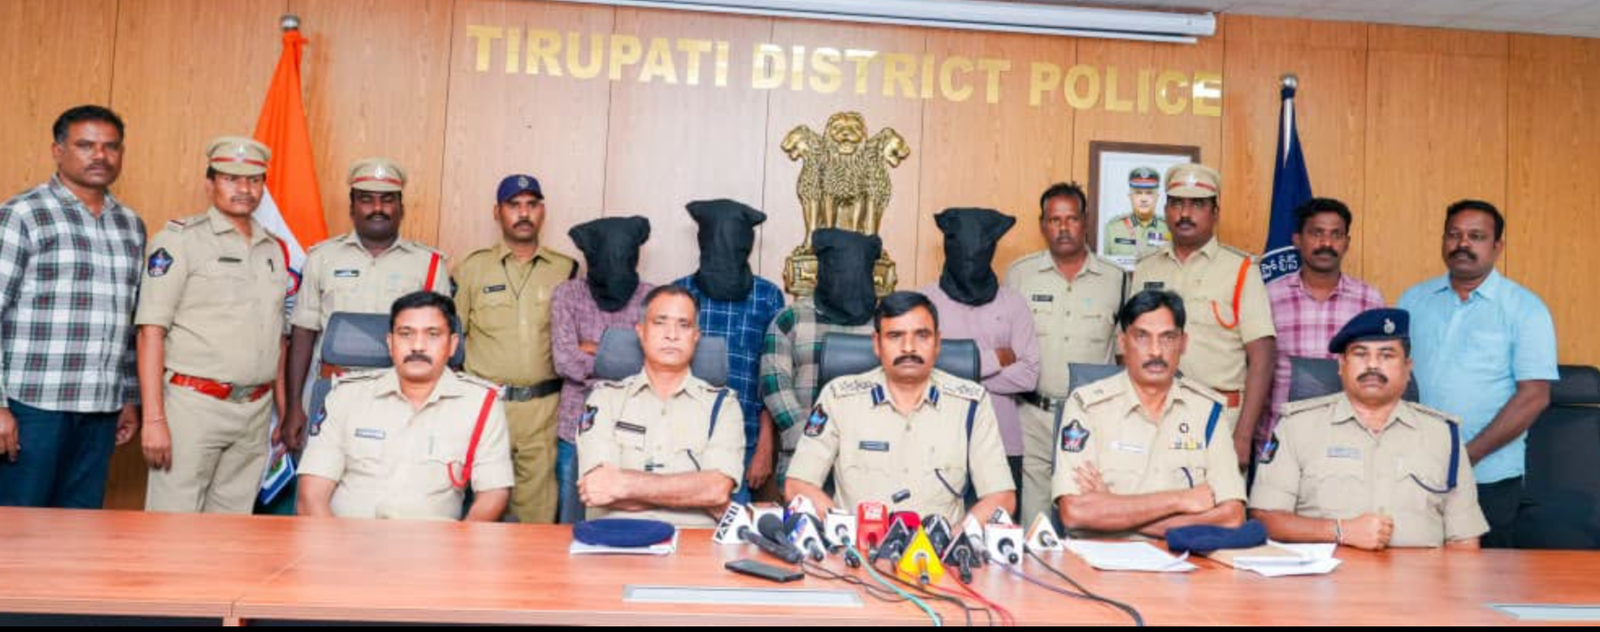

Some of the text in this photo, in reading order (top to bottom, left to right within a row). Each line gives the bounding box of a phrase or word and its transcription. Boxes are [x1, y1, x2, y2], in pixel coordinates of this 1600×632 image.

[466, 25, 1221, 117] TIRUPATI DISTRICT POLICE
